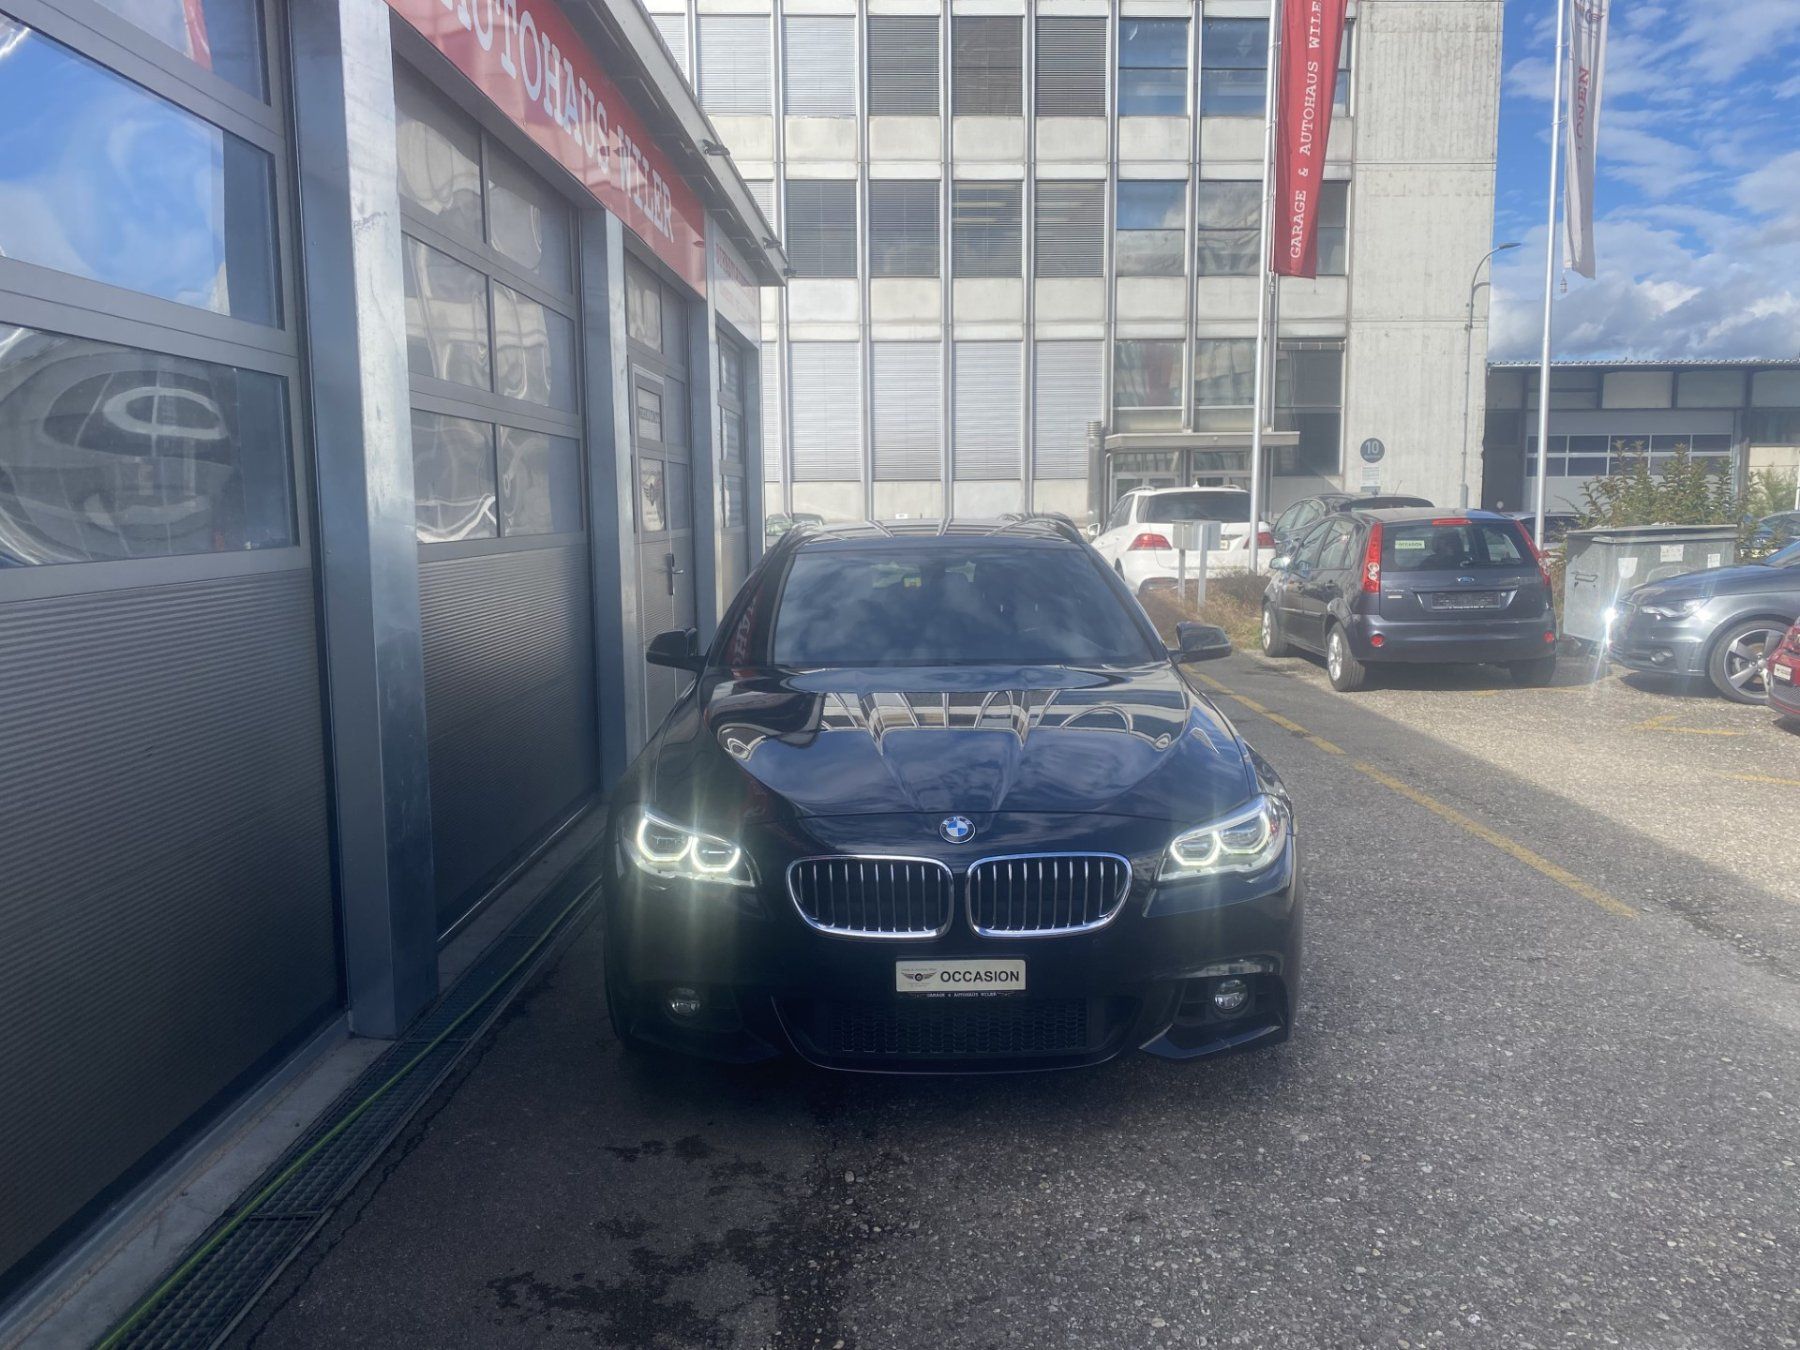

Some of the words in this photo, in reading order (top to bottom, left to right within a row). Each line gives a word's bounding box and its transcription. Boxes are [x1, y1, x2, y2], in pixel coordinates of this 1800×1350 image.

[1300, 61, 1318, 155] AUTOHAUS
[617, 124, 674, 243] WILER
[1298, 167, 1309, 176] &
[1290, 190, 1306, 258] GARAGE
[1366, 440, 1380, 454] 10
[940, 970, 1020, 983] OCCASION
